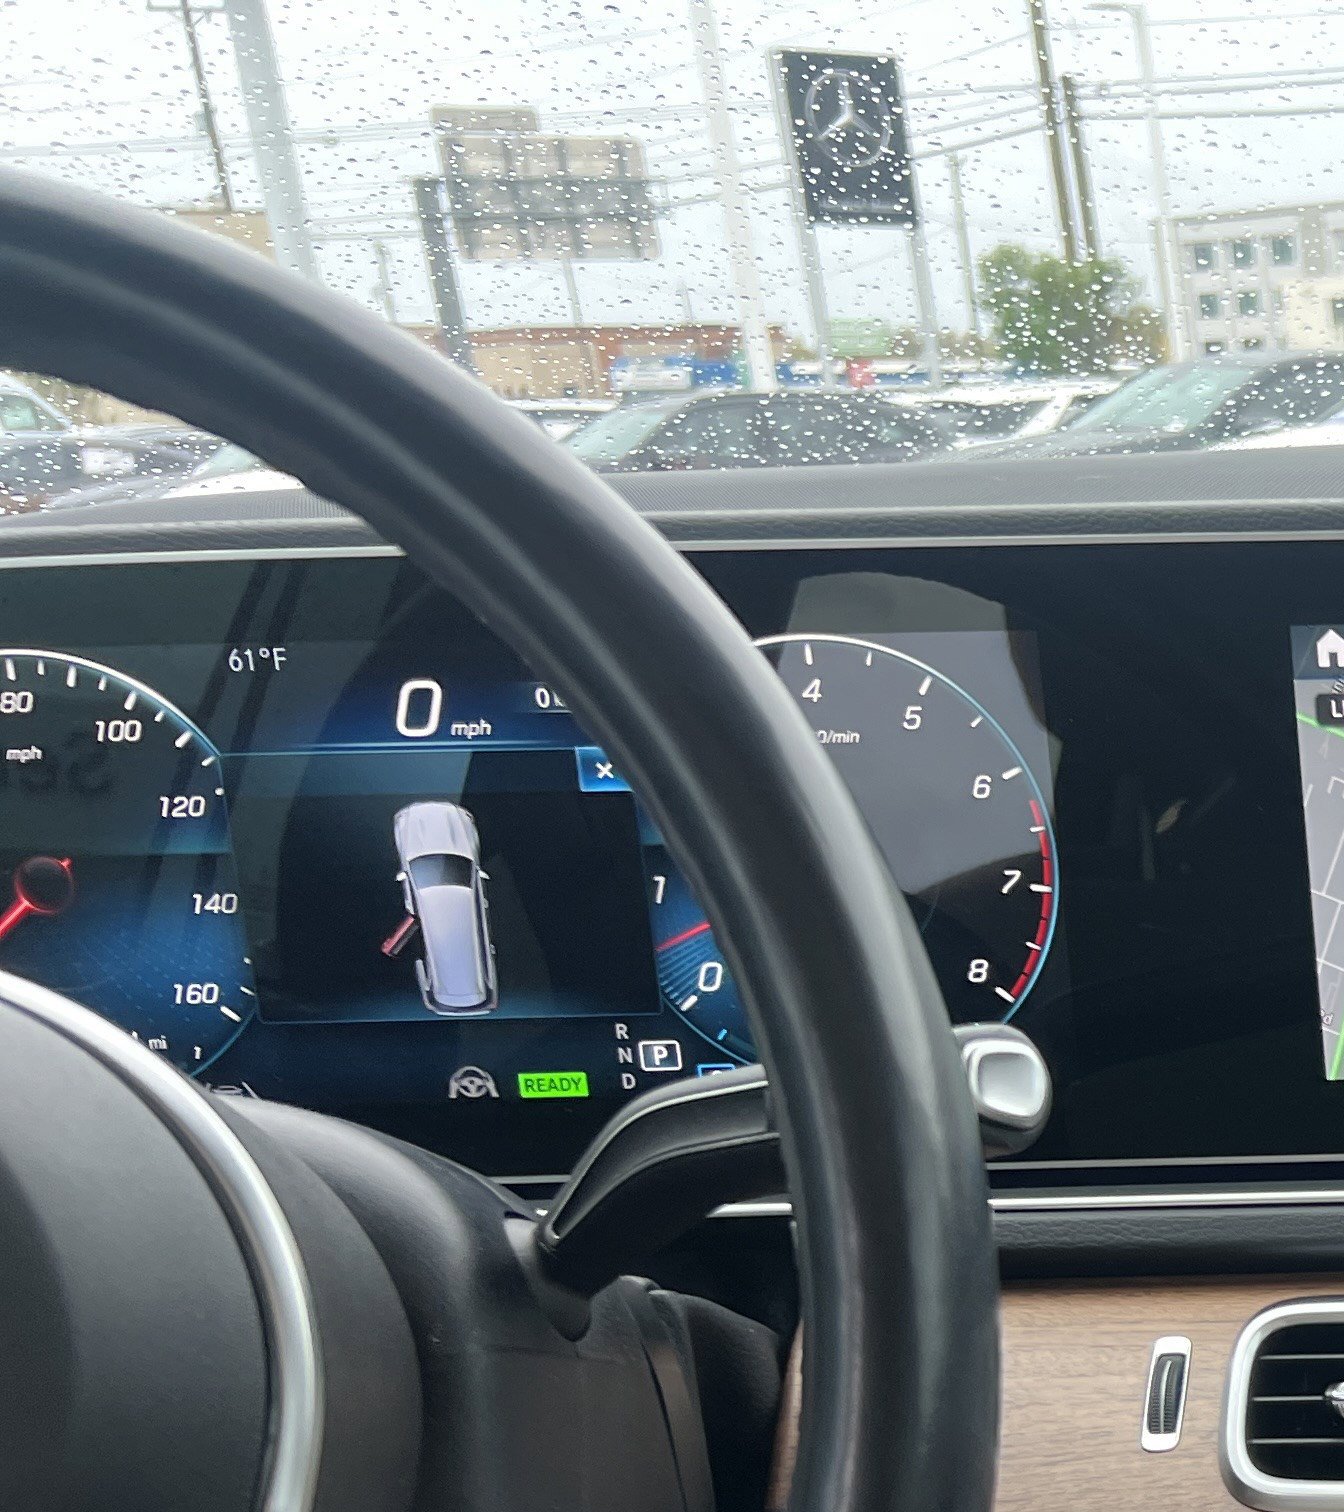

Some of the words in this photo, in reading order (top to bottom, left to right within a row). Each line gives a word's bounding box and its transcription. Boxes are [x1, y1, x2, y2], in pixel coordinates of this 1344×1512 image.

[228, 647, 286, 672] 61°F
[802, 678, 822, 703] 4
[0, 691, 33, 713] 80
[396, 678, 443, 738] 0
[451, 719, 492, 739] mph
[903, 705, 923, 730] 5
[95, 719, 142, 742] 100
[6, 745, 43, 763] mph
[972, 774, 992, 799] 6
[160, 796, 206, 818] 120
[652, 875, 666, 904] 1
[1001, 869, 1022, 894] 7
[193, 893, 238, 915] 140
[698, 961, 723, 992] 0
[968, 958, 989, 983] 8
[174, 983, 219, 1005] 160
[615, 1023, 629, 1040] R
[617, 1047, 634, 1064] N
[653, 1045, 668, 1066] P
[524, 1078, 582, 1093] READY
[621, 1073, 636, 1090] D
